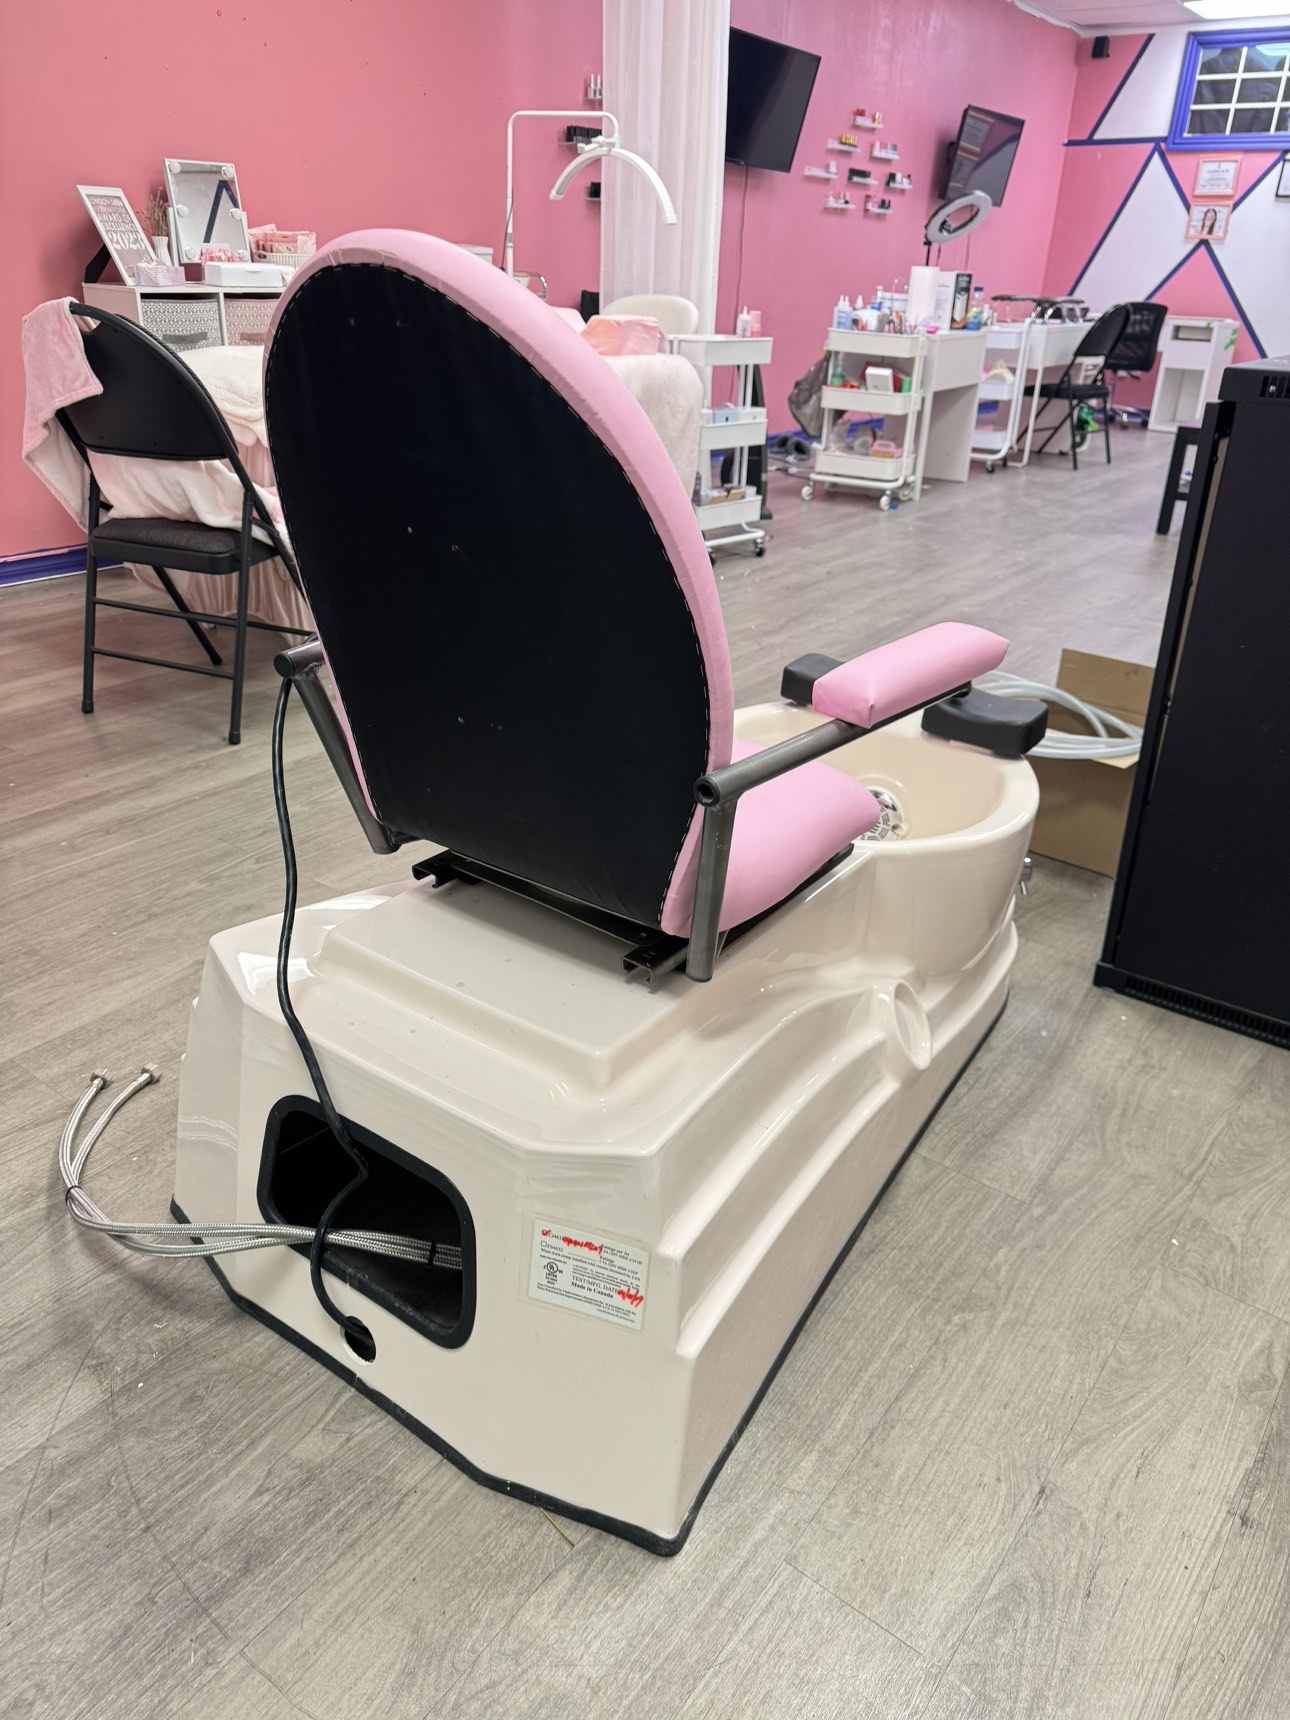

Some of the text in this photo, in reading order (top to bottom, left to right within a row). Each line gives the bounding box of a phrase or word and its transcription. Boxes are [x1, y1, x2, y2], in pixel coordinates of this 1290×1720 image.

[97, 212, 122, 222] AWARD
[108, 232, 145, 250] 2023
[571, 1281, 586, 1290] Made
[594, 1288, 614, 1298] Canada
